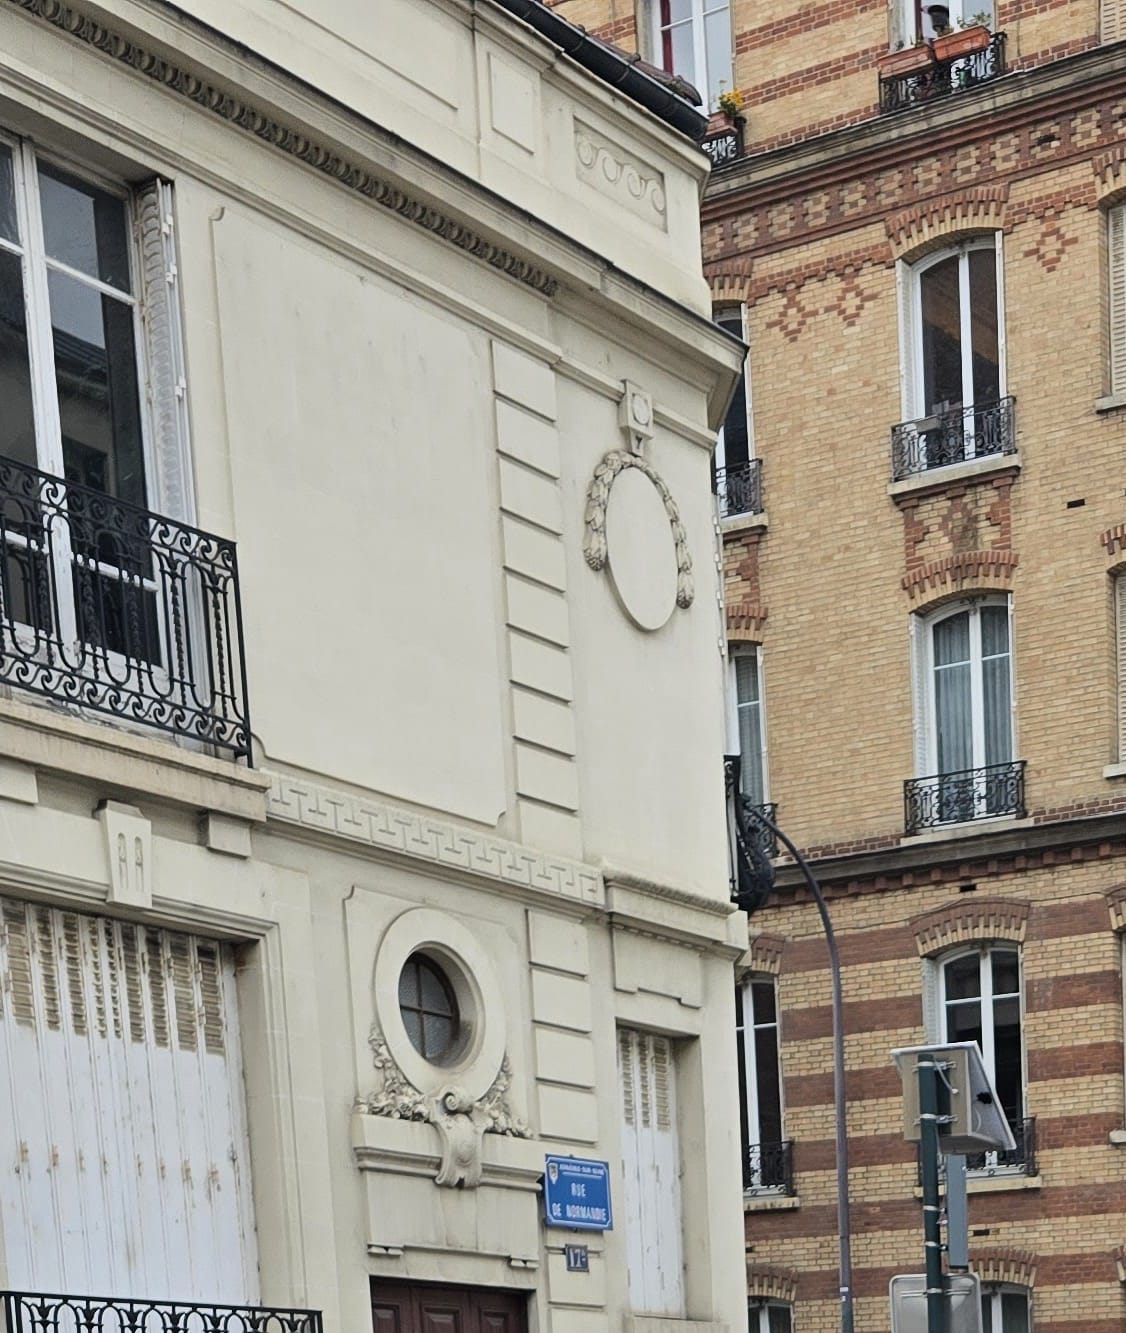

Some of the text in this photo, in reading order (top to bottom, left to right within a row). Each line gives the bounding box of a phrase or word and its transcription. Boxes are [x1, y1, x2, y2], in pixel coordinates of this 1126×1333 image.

[571, 1182, 586, 1197] RUE
[552, 1202, 607, 1221] DE NORMANDIE
